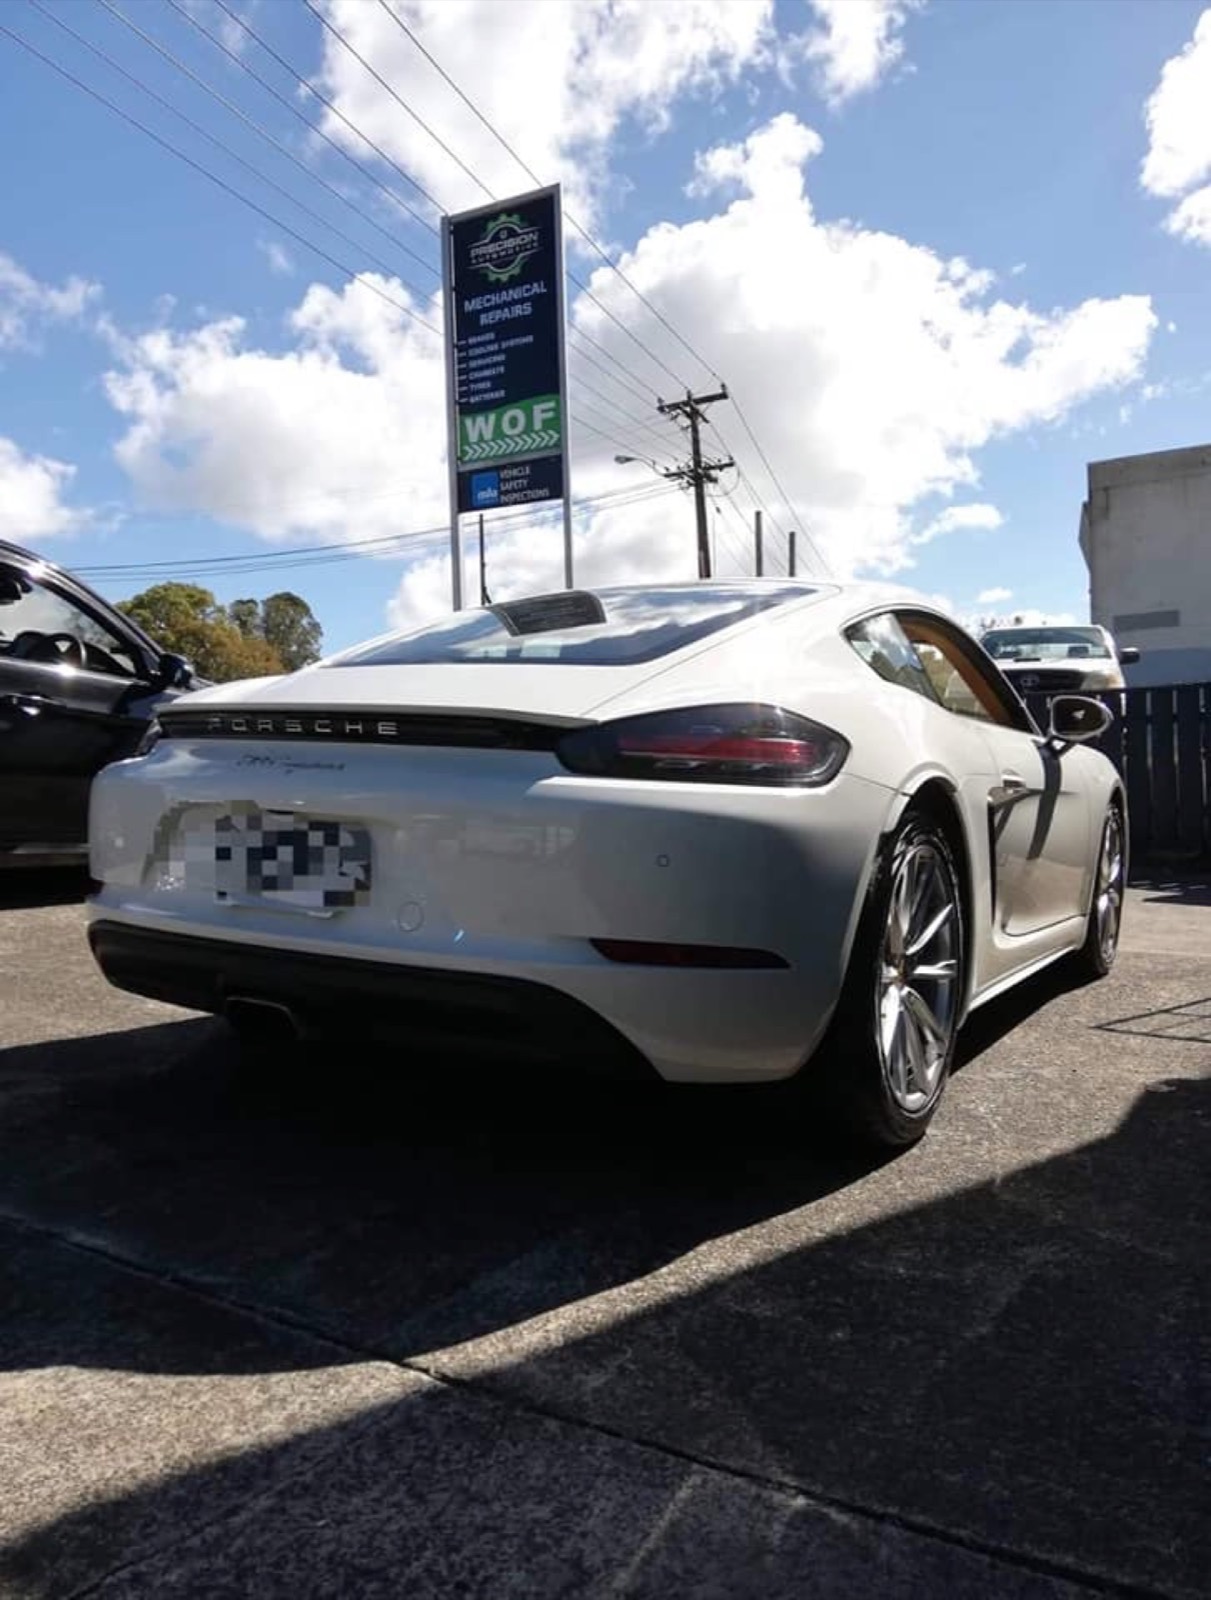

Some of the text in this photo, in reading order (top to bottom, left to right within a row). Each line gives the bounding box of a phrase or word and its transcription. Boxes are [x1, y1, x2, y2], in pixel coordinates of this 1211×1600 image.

[464, 280, 547, 312] MECHANICAL
[480, 302, 532, 326] REPAIRS
[464, 401, 556, 443] WOF
[207, 717, 399, 735] PORSCHE
